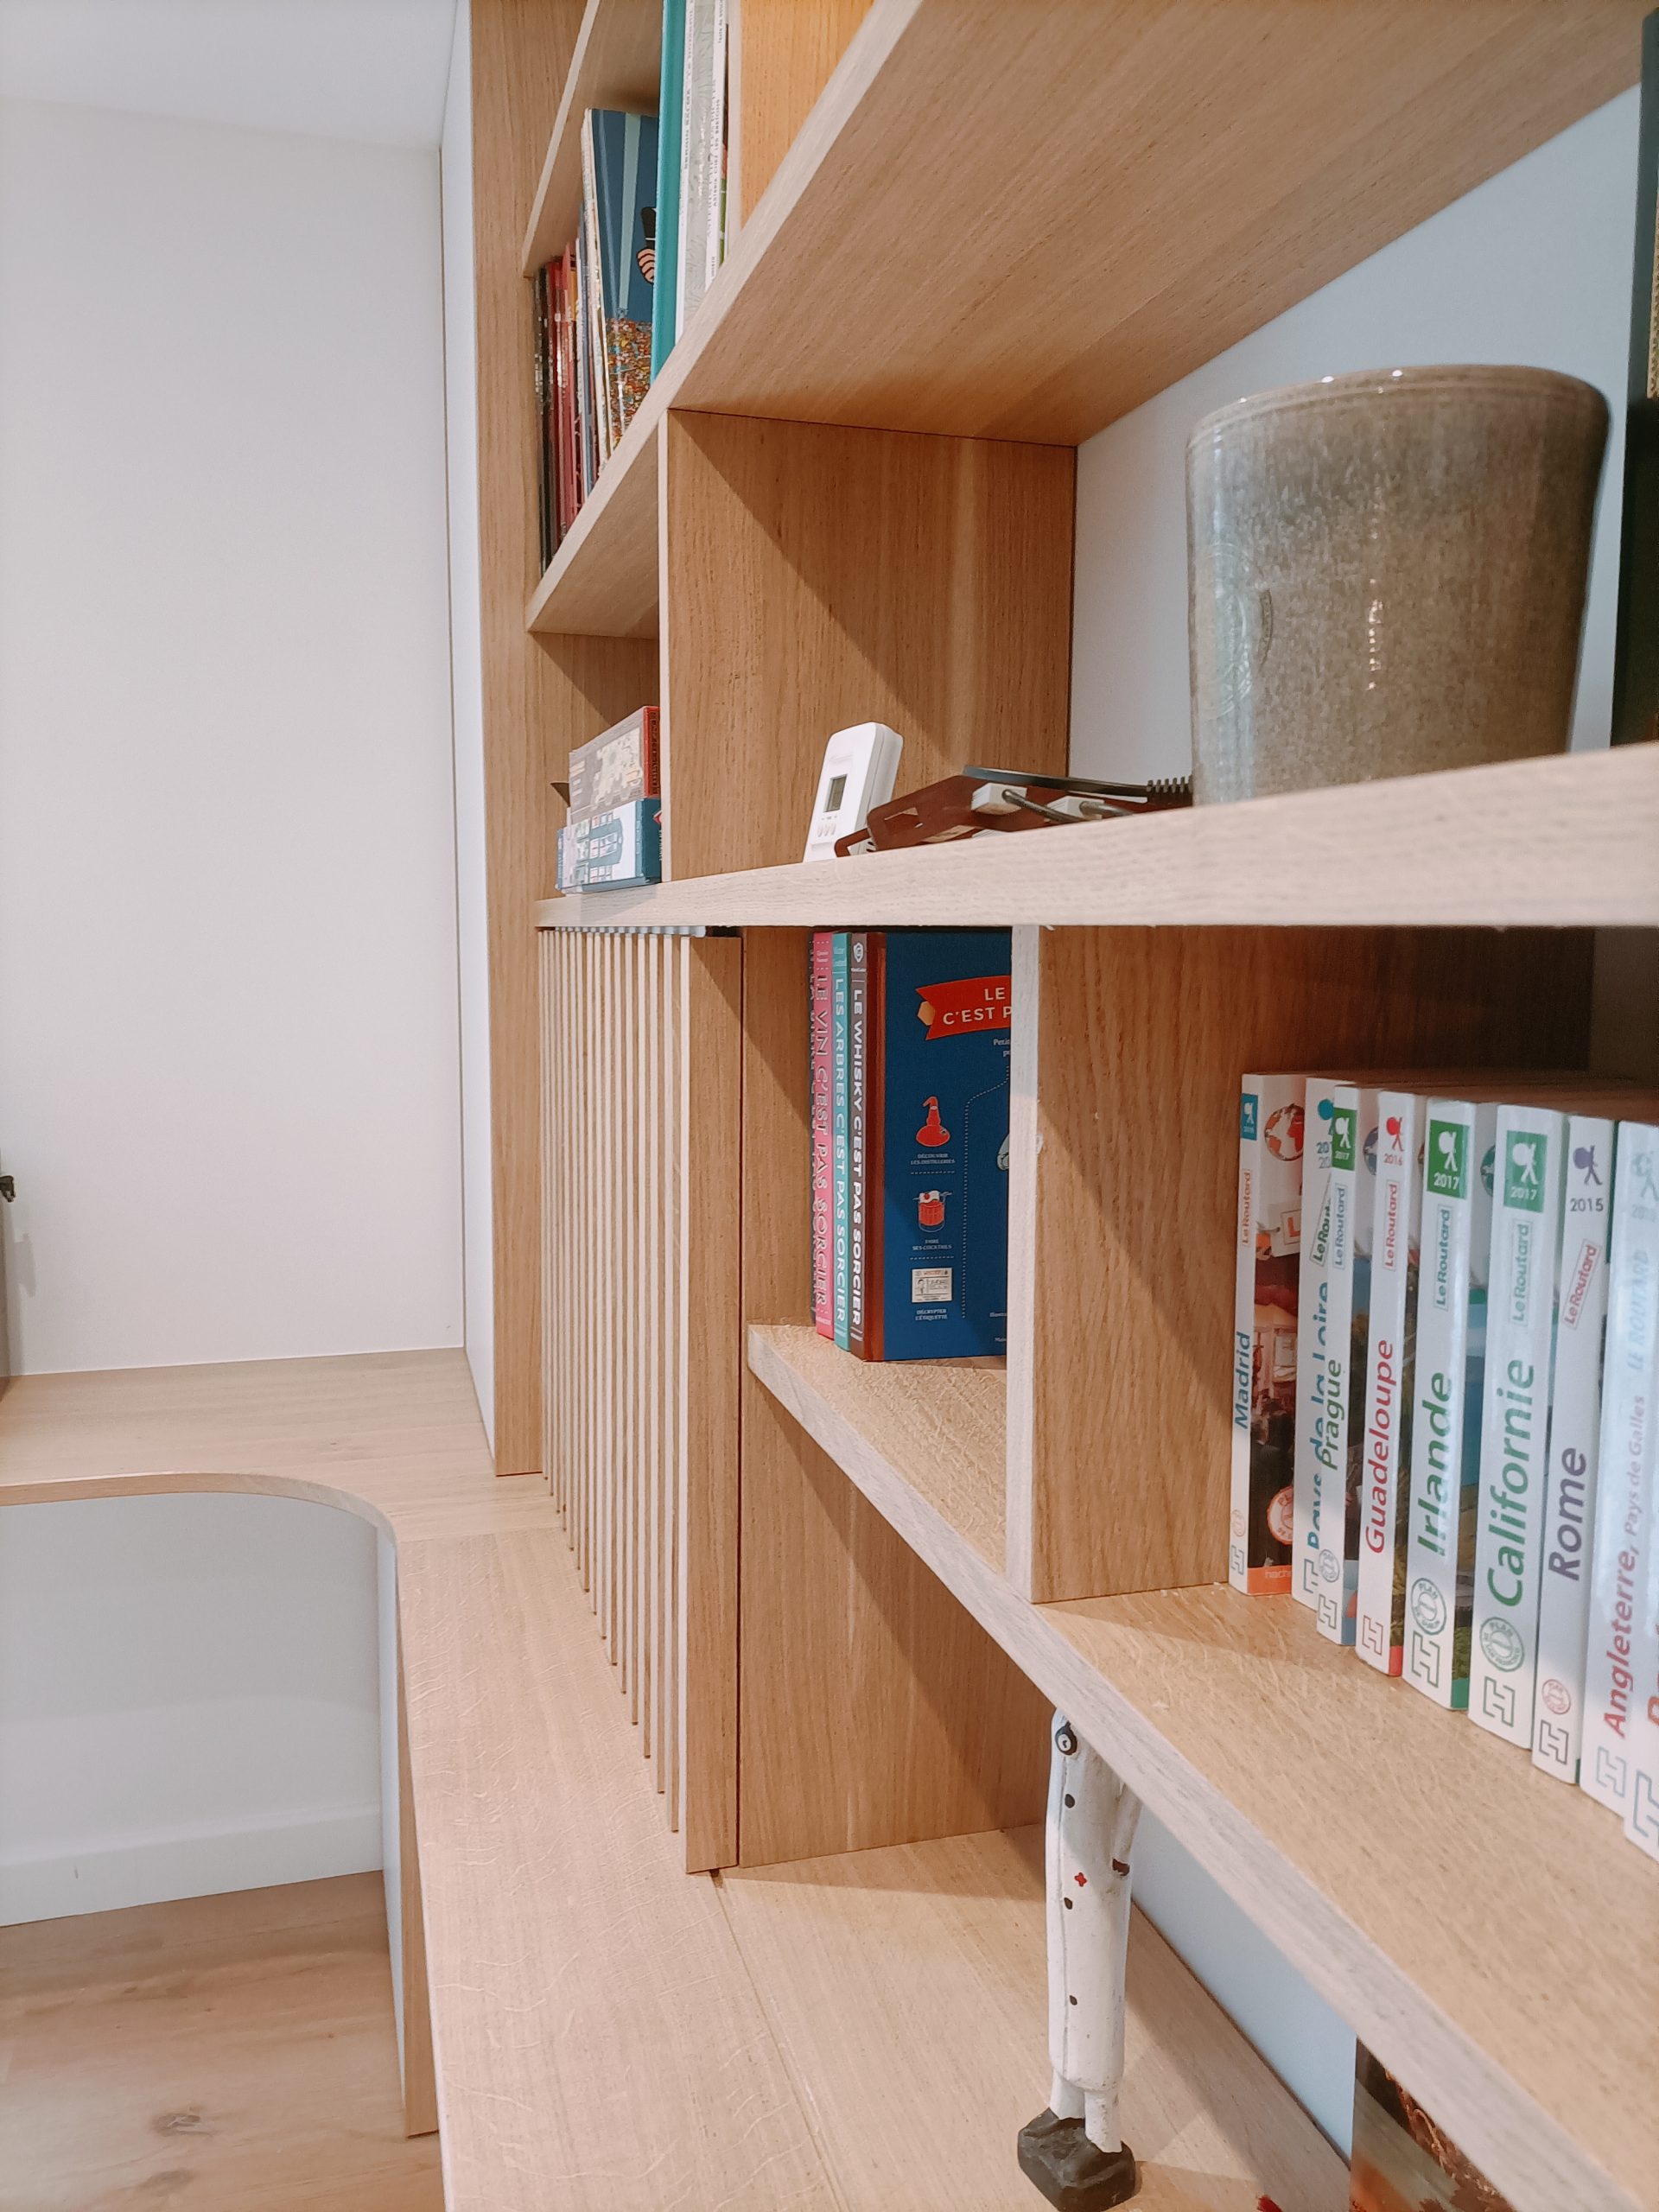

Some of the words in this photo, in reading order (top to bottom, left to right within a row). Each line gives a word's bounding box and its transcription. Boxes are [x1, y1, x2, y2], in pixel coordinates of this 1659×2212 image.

[816, 976, 828, 1001] LE
[836, 978, 845, 1016] LES
[854, 989, 862, 1014] LE
[943, 1007, 995, 1026] C'EST
[984, 987, 1006, 1001] LE
[815, 1009, 828, 1056] VIN
[836, 1021, 845, 1108] ARBRES
[854, 1020, 862, 1112] WHISKY
[816, 1065, 828, 1136] C'EST
[816, 1141, 828, 1190] PAS
[836, 1113, 845, 1175] C'EST
[853, 1116, 862, 1178] C'EST
[1383, 1154, 1402, 1166] 2016
[836, 1180, 846, 1219] PAS
[853, 1181, 862, 1224] PAS
[1433, 1172, 1460, 1190] 2017
[1510, 1185, 1538, 1201] 2017
[1570, 1198, 1605, 1212] 2015
[816, 1198, 828, 1306] SORCIER
[836, 1224, 846, 1322] SORCIER
[852, 1228, 862, 1325] SORCIER
[1233, 1331, 1251, 1430] Madrid
[1321, 1359, 1345, 1471] Prague
[1628, 1395, 1646, 1457] Galles
[1364, 1339, 1397, 1554] Guadeloupe
[1417, 1372, 1455, 1557] Irlande
[1626, 1461, 1642, 1486] de
[1487, 1359, 1535, 1607] Californie
[1624, 1491, 1643, 1536] Pays
[1548, 1447, 1587, 1582] Rome
[1604, 1544, 1640, 1739] Angleterre,
